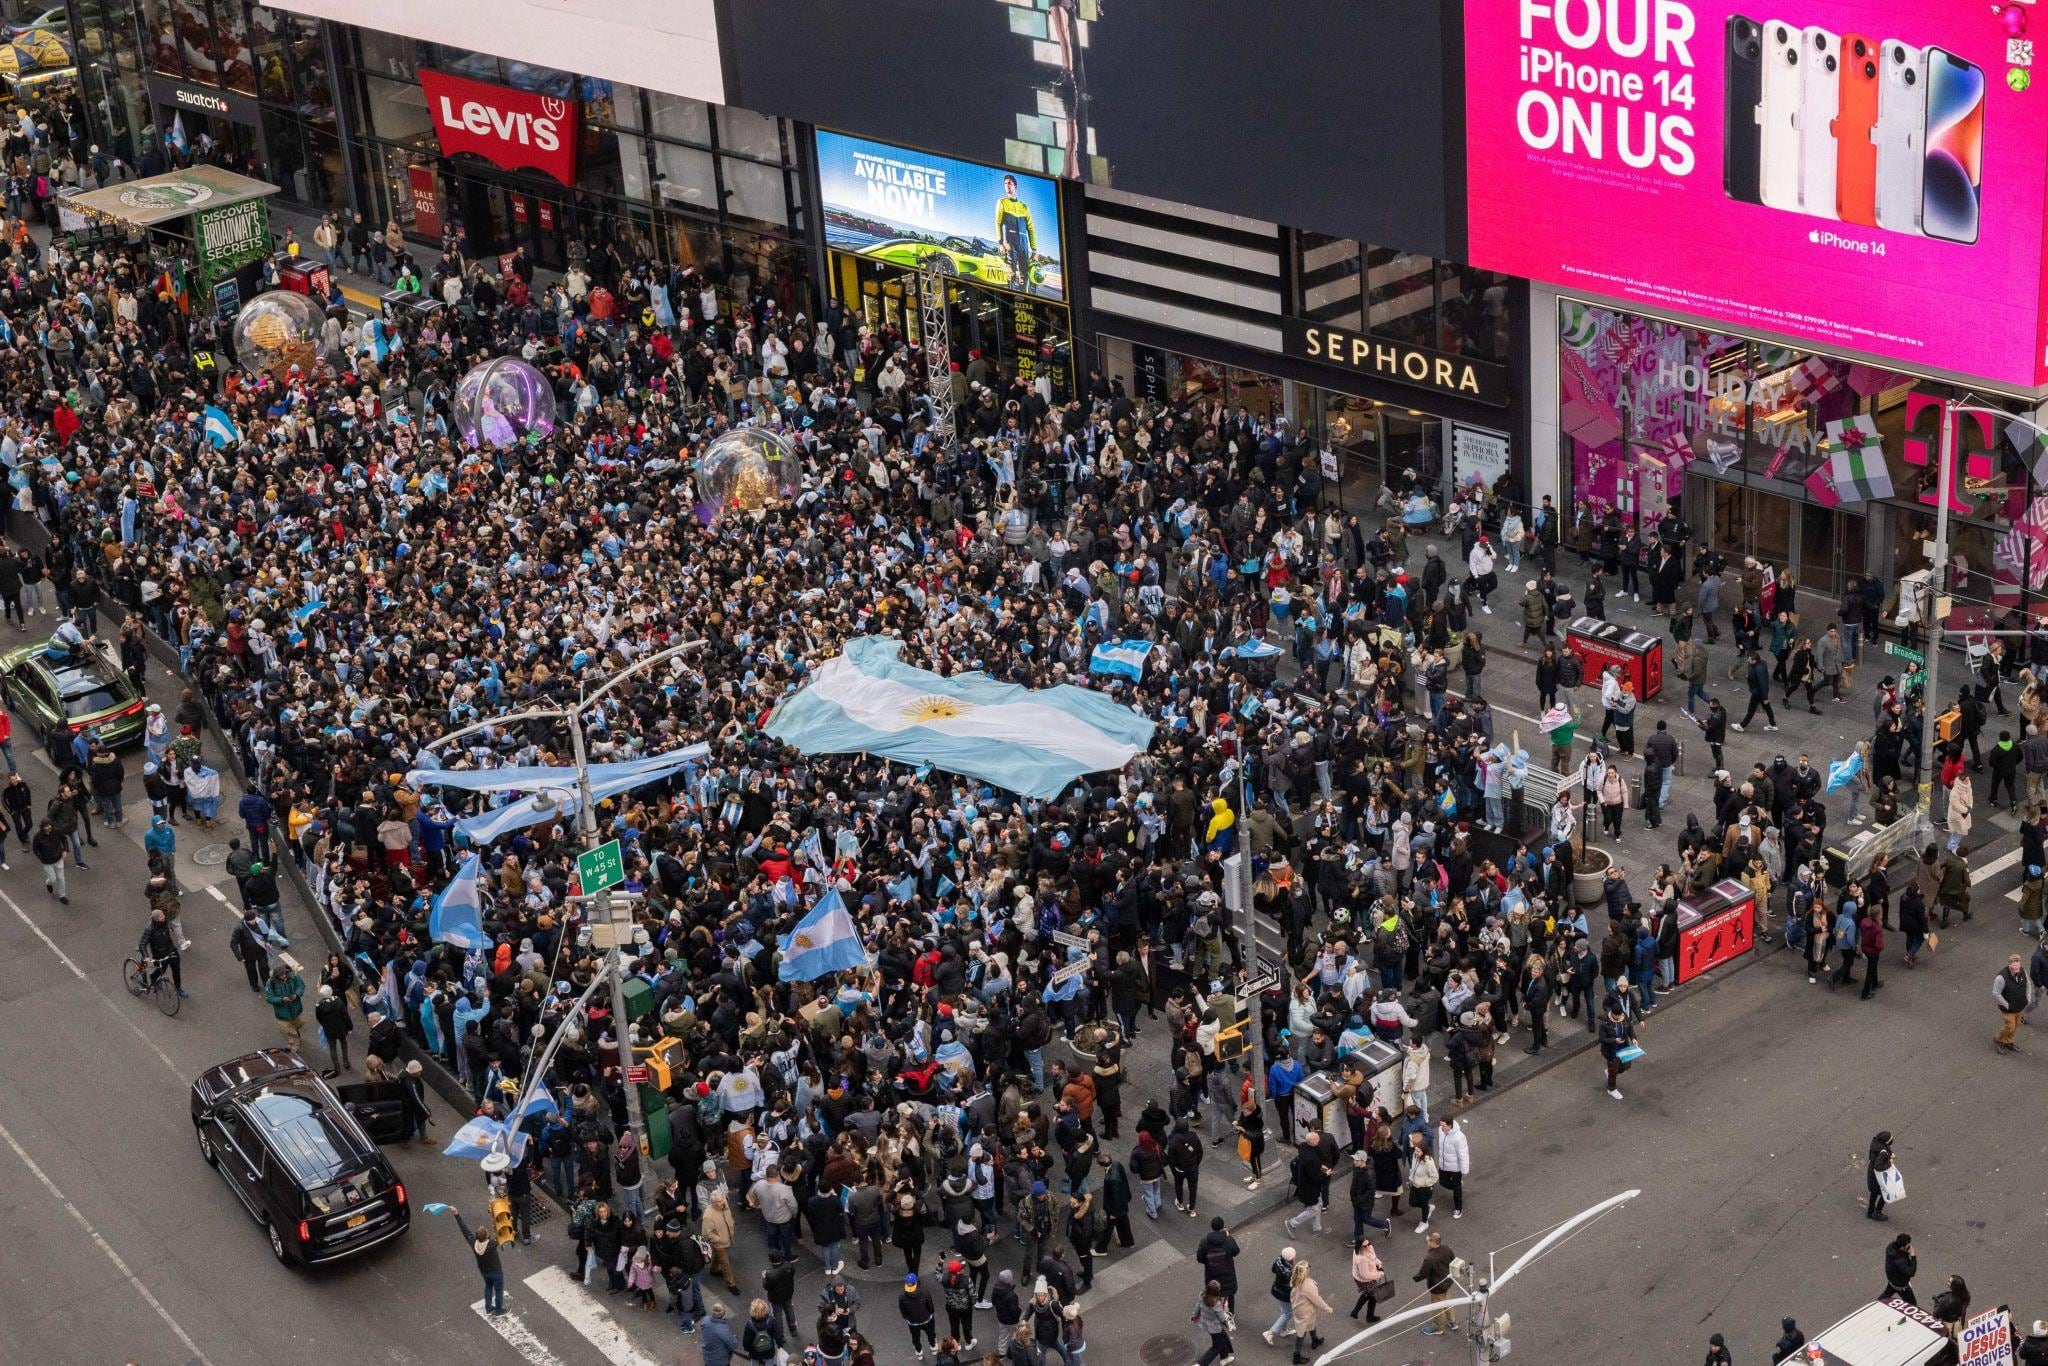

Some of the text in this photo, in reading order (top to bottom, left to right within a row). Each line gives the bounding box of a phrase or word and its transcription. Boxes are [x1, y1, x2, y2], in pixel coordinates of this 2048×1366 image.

[1520, 0, 1695, 67] FOUR
[1520, 45, 1695, 110] iPhone 14
[176, 90, 220, 110] swatch
[1517, 90, 1695, 176] ON US
[854, 159, 946, 196] AVAILABLE
[414, 189, 434, 200] SALE
[867, 180, 935, 219] NOW!
[201, 201, 258, 225] DISCOVER
[203, 211, 261, 250] BROADWAY'S
[1820, 231, 1886, 257] iPhone 14
[207, 237, 263, 261] SECRETS
[1014, 301, 1033, 310] EXTRA
[1014, 309, 1036, 325] 20%
[1015, 323, 1035, 334] OFF
[1306, 328, 1479, 394] SEPHORA
[1658, 358, 1785, 411] HOLIDAY
[1894, 645, 1924, 666] Broadway
[586, 857, 616, 878] W 45 St
[593, 851, 604, 862] TO
[1888, 1298, 1945, 1329] 442018
[1963, 1314, 2004, 1342] ONLY
[1963, 1326, 2007, 1361] JESUS
